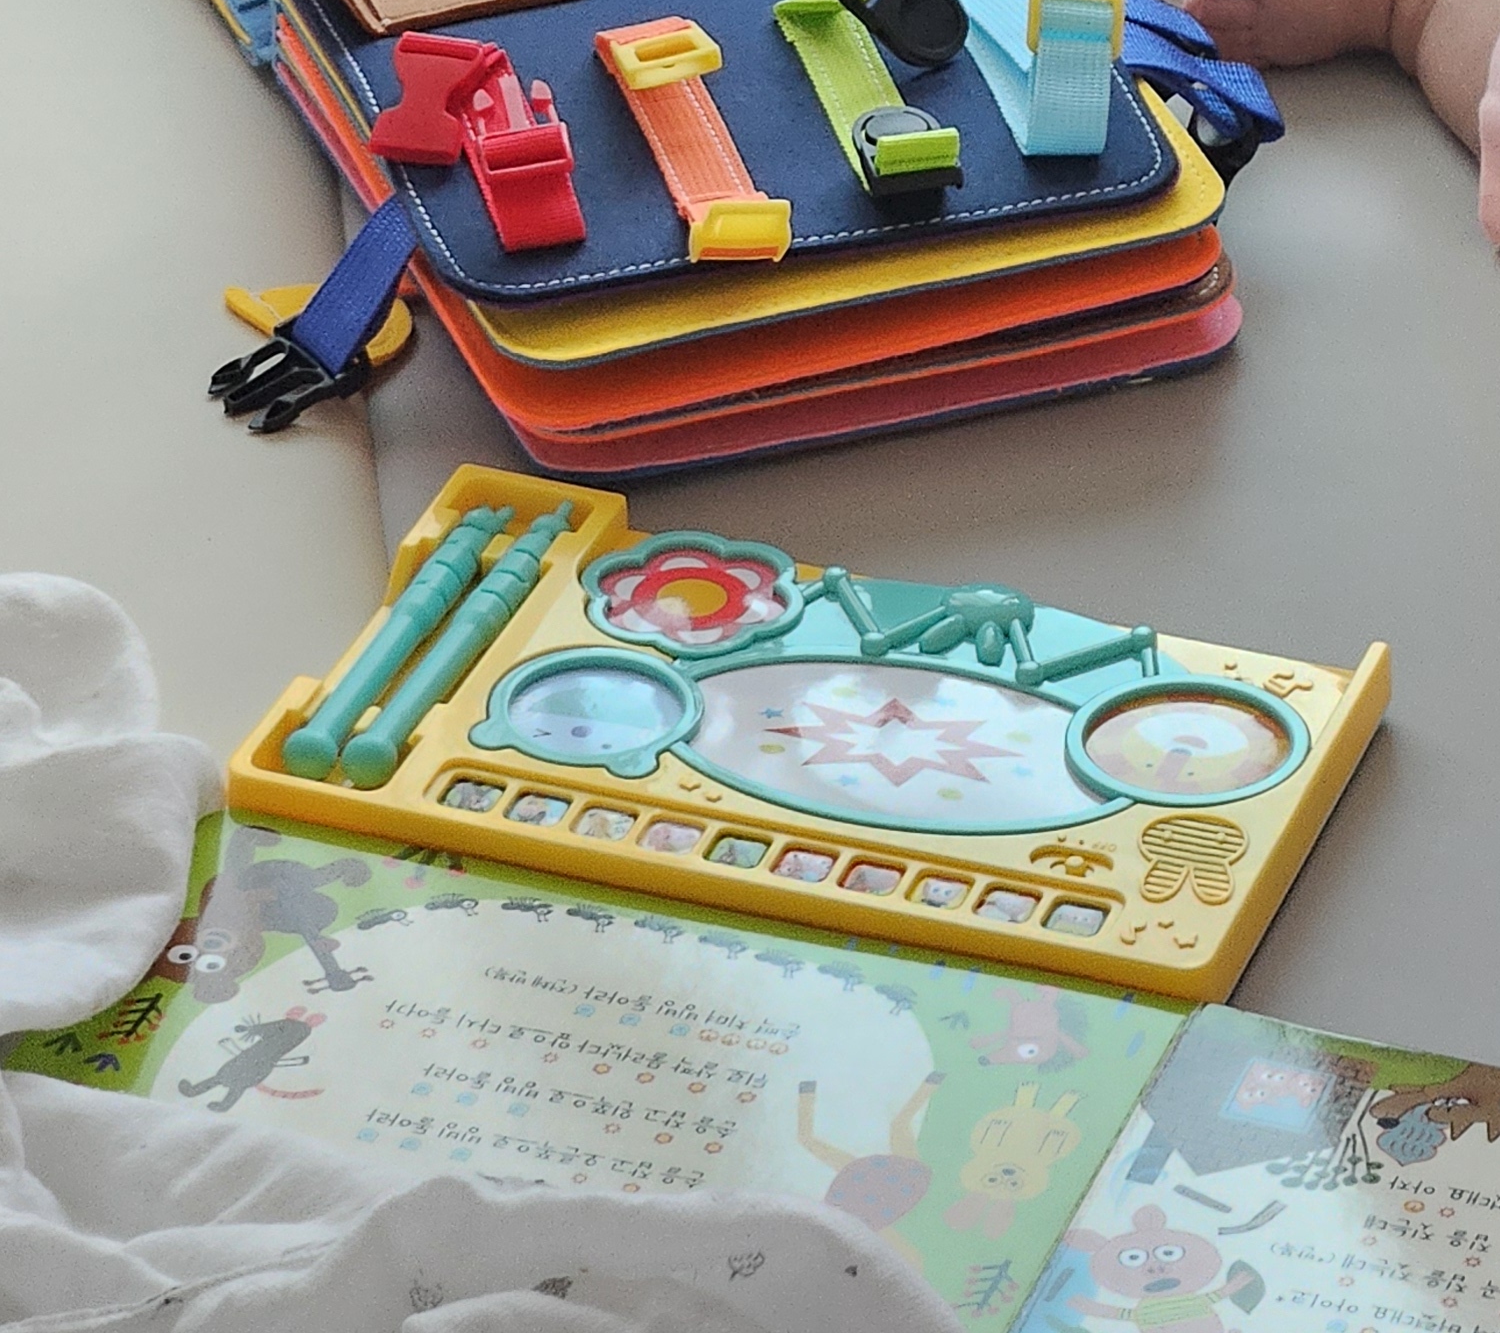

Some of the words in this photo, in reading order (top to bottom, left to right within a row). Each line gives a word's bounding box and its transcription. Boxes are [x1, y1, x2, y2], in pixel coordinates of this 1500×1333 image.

[582, 985, 653, 1013] 돌아라
[654, 999, 699, 1022] 빙빙
[455, 1012, 502, 1035] 다시
[703, 1009, 750, 1031] 치며
[507, 1024, 573, 1050] 앞으로
[422, 1062, 492, 1090] 돌아라
[493, 1075, 540, 1100] 빙빙
[547, 1088, 635, 1120] 왼쪽으로
[365, 1107, 435, 1136] 돌아라
[643, 1107, 687, 1130] 잡고
[691, 1115, 738, 1139] 손을
[436, 1121, 483, 1145] 빙빙
[492, 1133, 606, 1167] 오른쪽으로
[610, 1157, 654, 1181] 잡고
[659, 1166, 706, 1190] 손을
[1387, 1174, 1436, 1196] 아자
[1363, 1214, 1436, 1242] 짓는데
[1445, 1228, 1493, 1254] 집을
[1340, 1252, 1413, 1283] 짓는데
[1422, 1269, 1469, 1295] 집을
